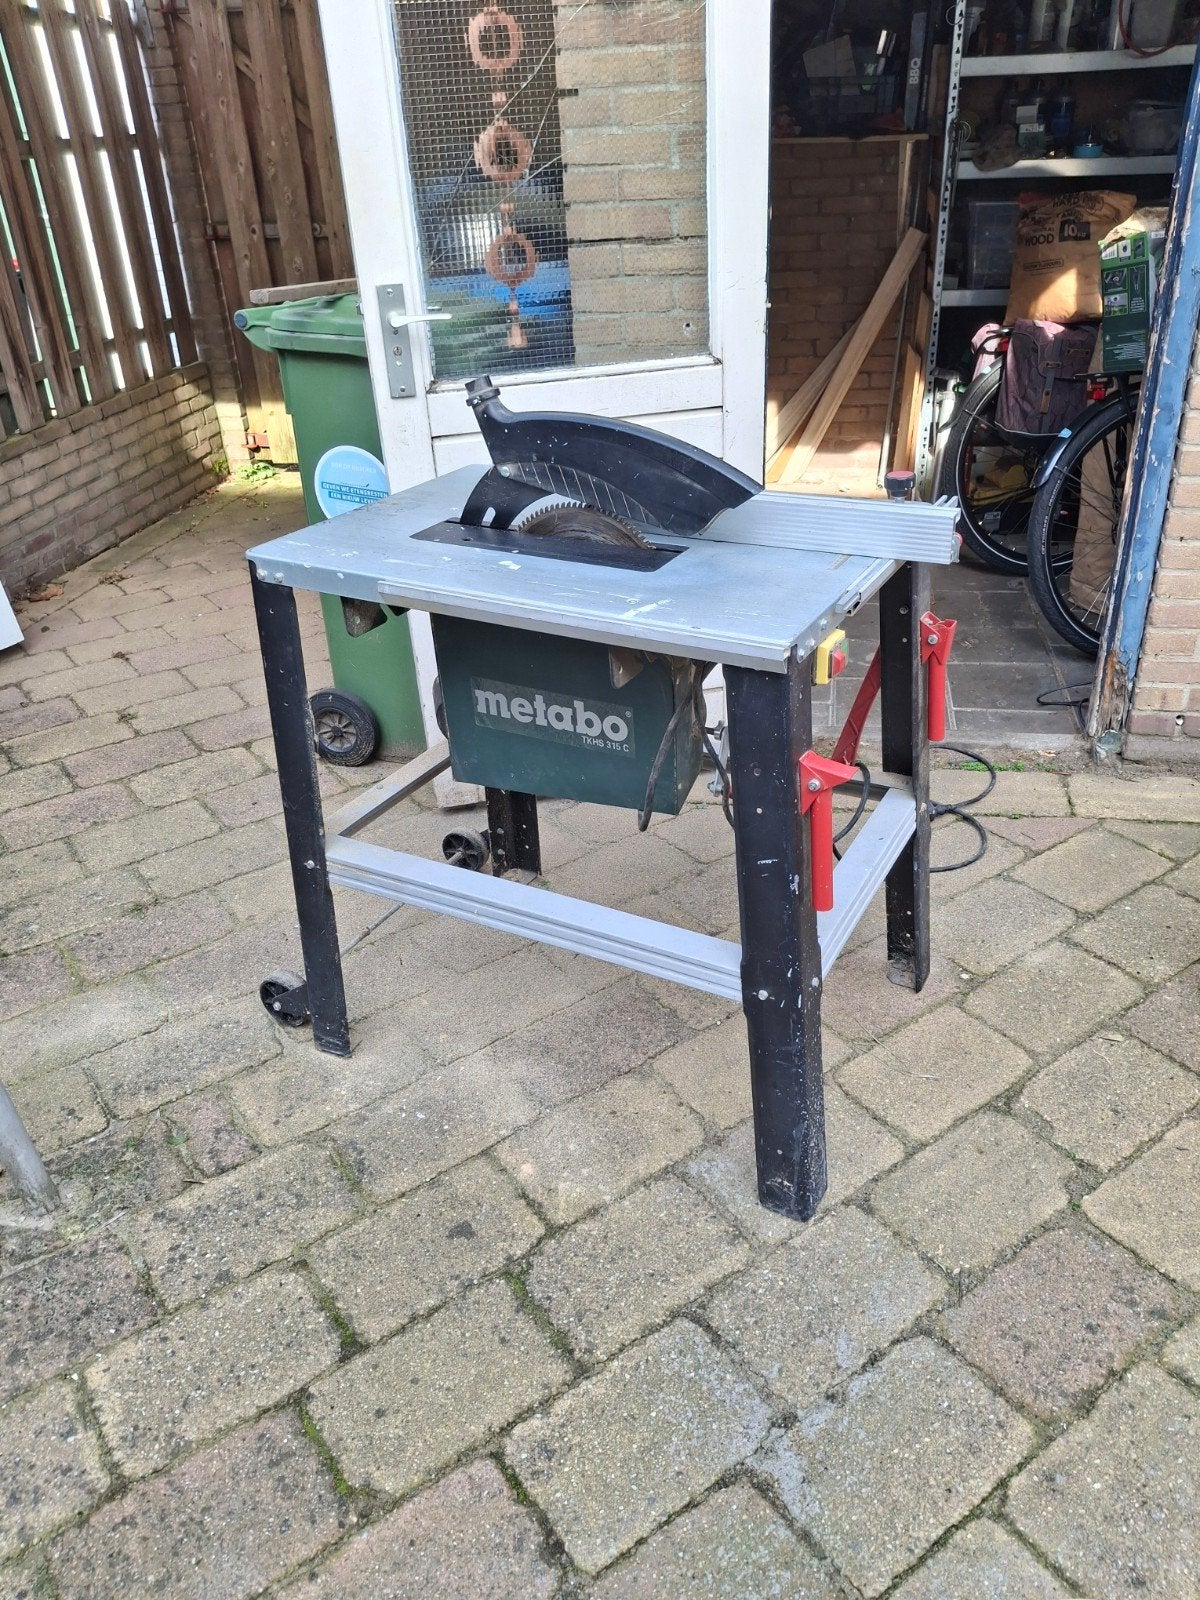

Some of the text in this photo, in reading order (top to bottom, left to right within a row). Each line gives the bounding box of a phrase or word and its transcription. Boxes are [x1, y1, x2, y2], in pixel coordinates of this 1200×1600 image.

[909, 57, 921, 84] BBQ
[1064, 224, 1078, 237] 10
[322, 482, 340, 490] GEVEN
[474, 689, 629, 742] metabo
[581, 736, 630, 752] TKHS 315 C
